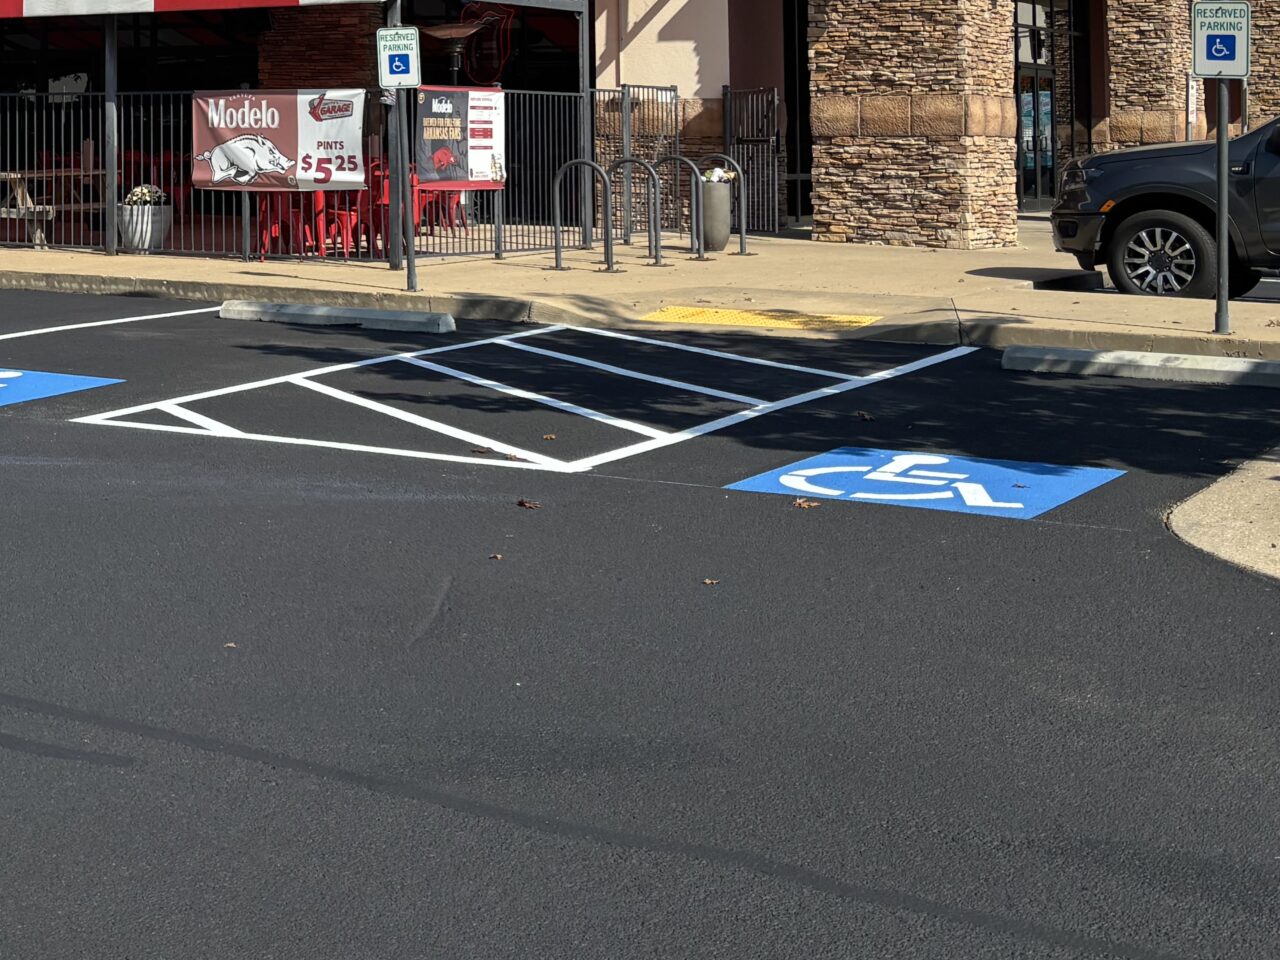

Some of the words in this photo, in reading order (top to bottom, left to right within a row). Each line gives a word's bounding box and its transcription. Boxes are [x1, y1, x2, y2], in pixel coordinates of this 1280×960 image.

[1196, 8, 1246, 19] RESERVED
[1200, 21, 1243, 31] PARKING
[380, 33, 416, 42] RESERVED
[383, 43, 414, 52] PARKING
[207, 98, 280, 129] Modelo
[320, 103, 351, 115] GARAGE
[317, 141, 345, 150] PINTS
